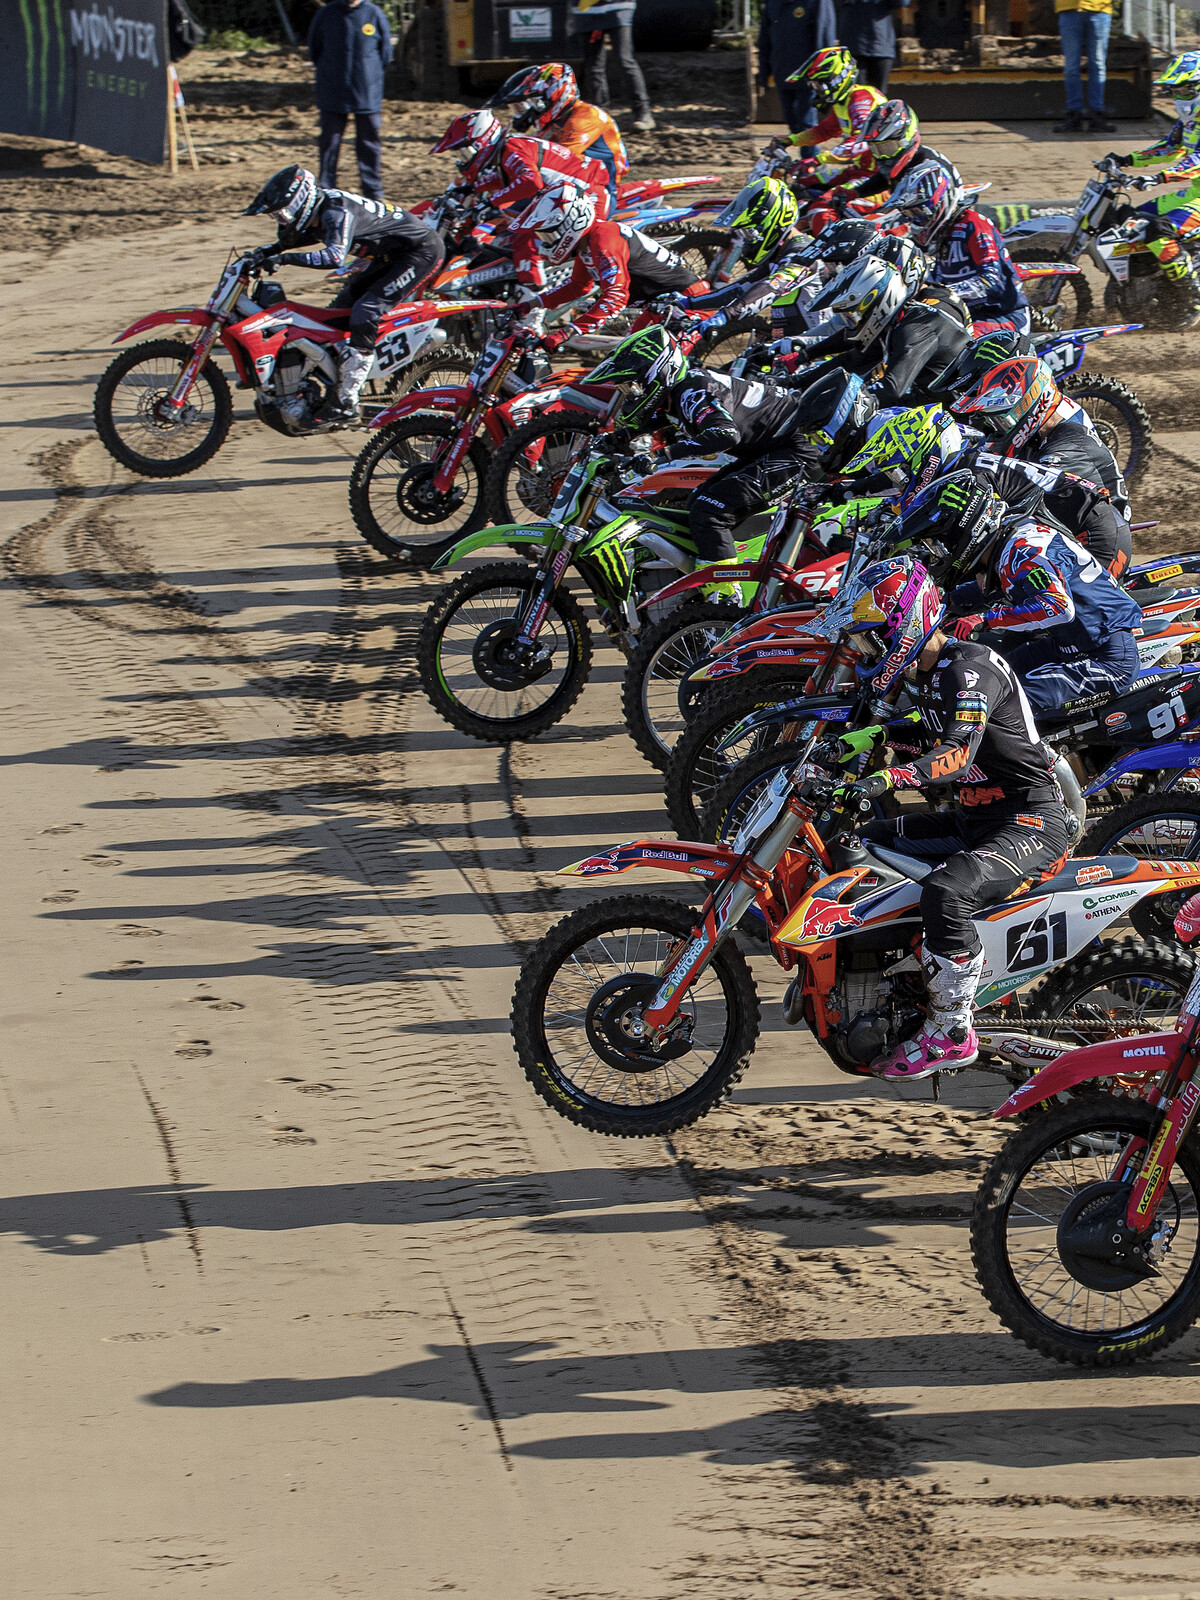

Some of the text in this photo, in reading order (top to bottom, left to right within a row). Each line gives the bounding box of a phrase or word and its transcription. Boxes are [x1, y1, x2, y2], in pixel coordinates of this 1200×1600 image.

[70, 3, 159, 69] MONSTER
[86, 69, 149, 98] ENERGY
[383, 266, 417, 297] SHOT
[387, 306, 416, 317] HONDA
[375, 332, 411, 371] 53
[1151, 566, 1180, 580] PIRELLI
[524, 588, 545, 635] DUNLOP
[873, 636, 915, 691] Red Bull
[1074, 691, 1110, 706] MONSTER
[1147, 695, 1187, 739] 91
[931, 745, 970, 779] KTM
[956, 763, 988, 783] ull
[642, 849, 688, 861] Red Bull
[1092, 905, 1122, 918] ATHENA
[1006, 911, 1069, 973] 61
[672, 936, 708, 987] MOTOREX
[997, 973, 1032, 989] MOTOREX
[1123, 1046, 1166, 1058] MOTUL
[536, 1063, 584, 1110] PIRELLI
[1137, 1166, 1163, 1212] ACERBIS
[1098, 1324, 1165, 1353] PIRELLI
